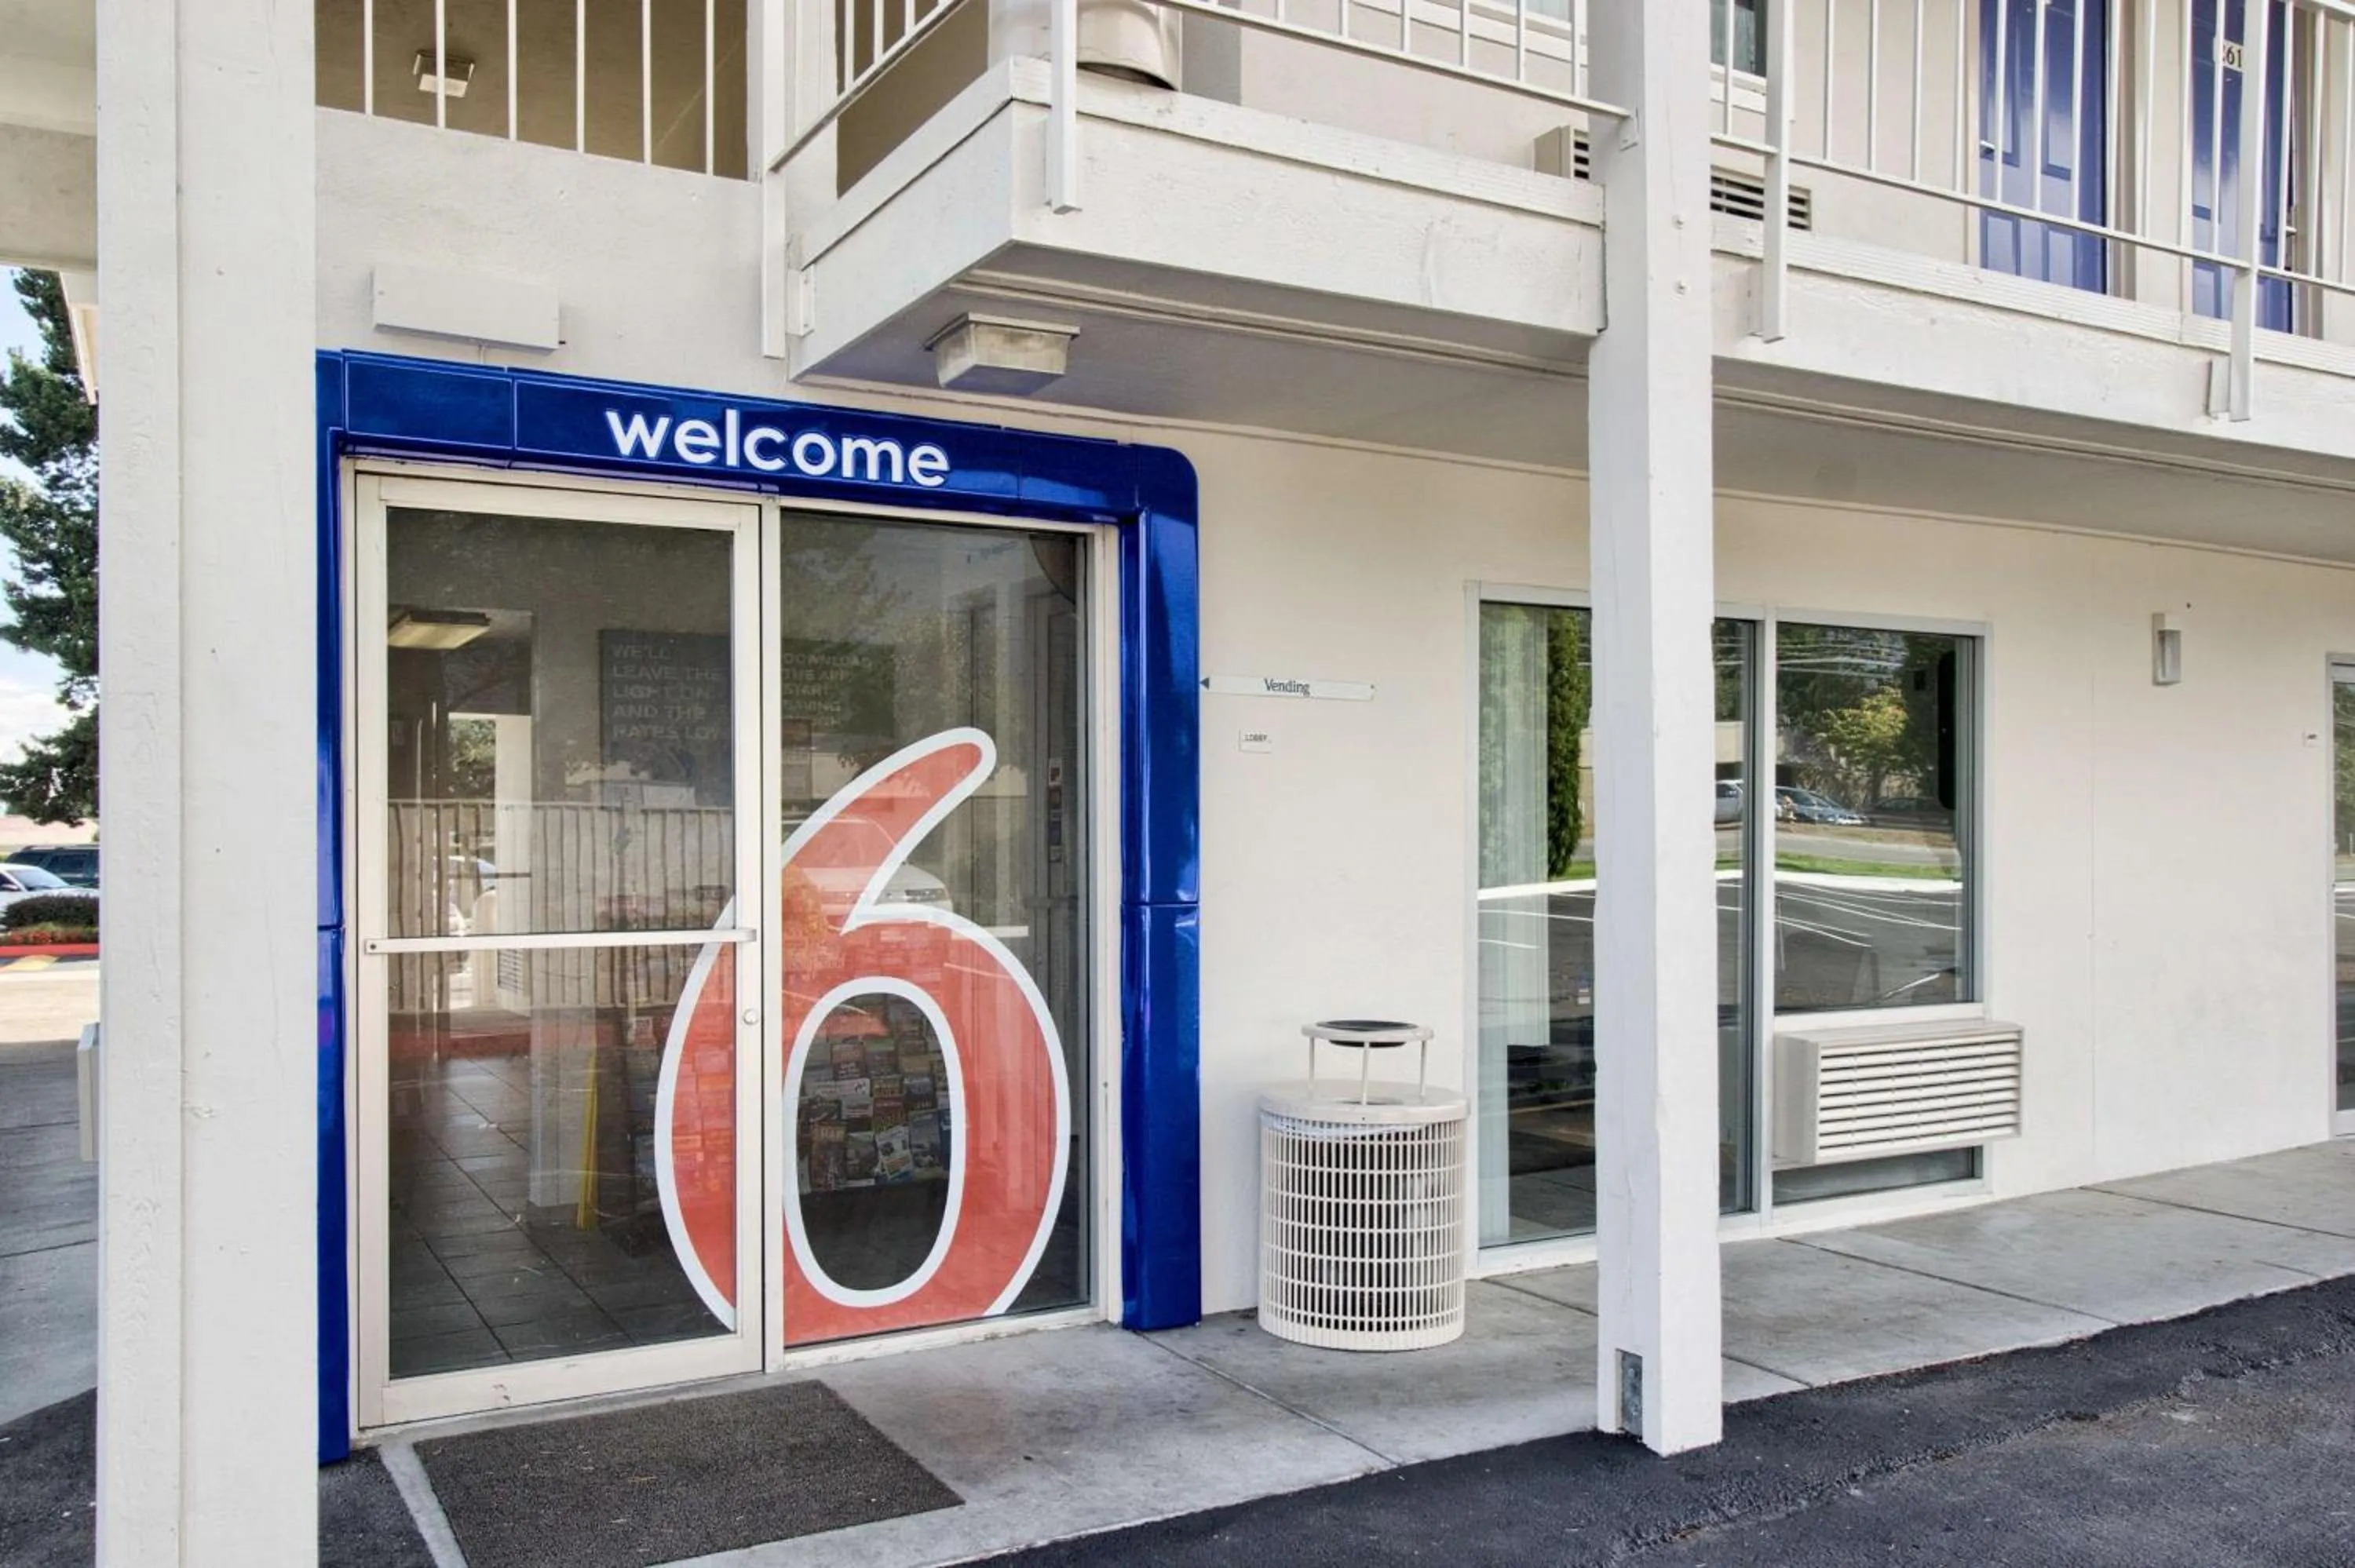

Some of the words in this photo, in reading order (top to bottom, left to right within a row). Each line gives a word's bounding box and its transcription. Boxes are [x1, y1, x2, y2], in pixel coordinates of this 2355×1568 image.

[2223, 44, 2243, 69] 61
[604, 408, 951, 488] welcome
[612, 665, 678, 680] LEAVE
[684, 666, 725, 681] THE
[1264, 678, 1311, 696] Vending
[612, 704, 659, 718] AND
[663, 706, 706, 720] THE
[612, 724, 679, 740] RATES
[1244, 733, 1269, 742] LOBBY
[653, 727, 1071, 1345] 6
